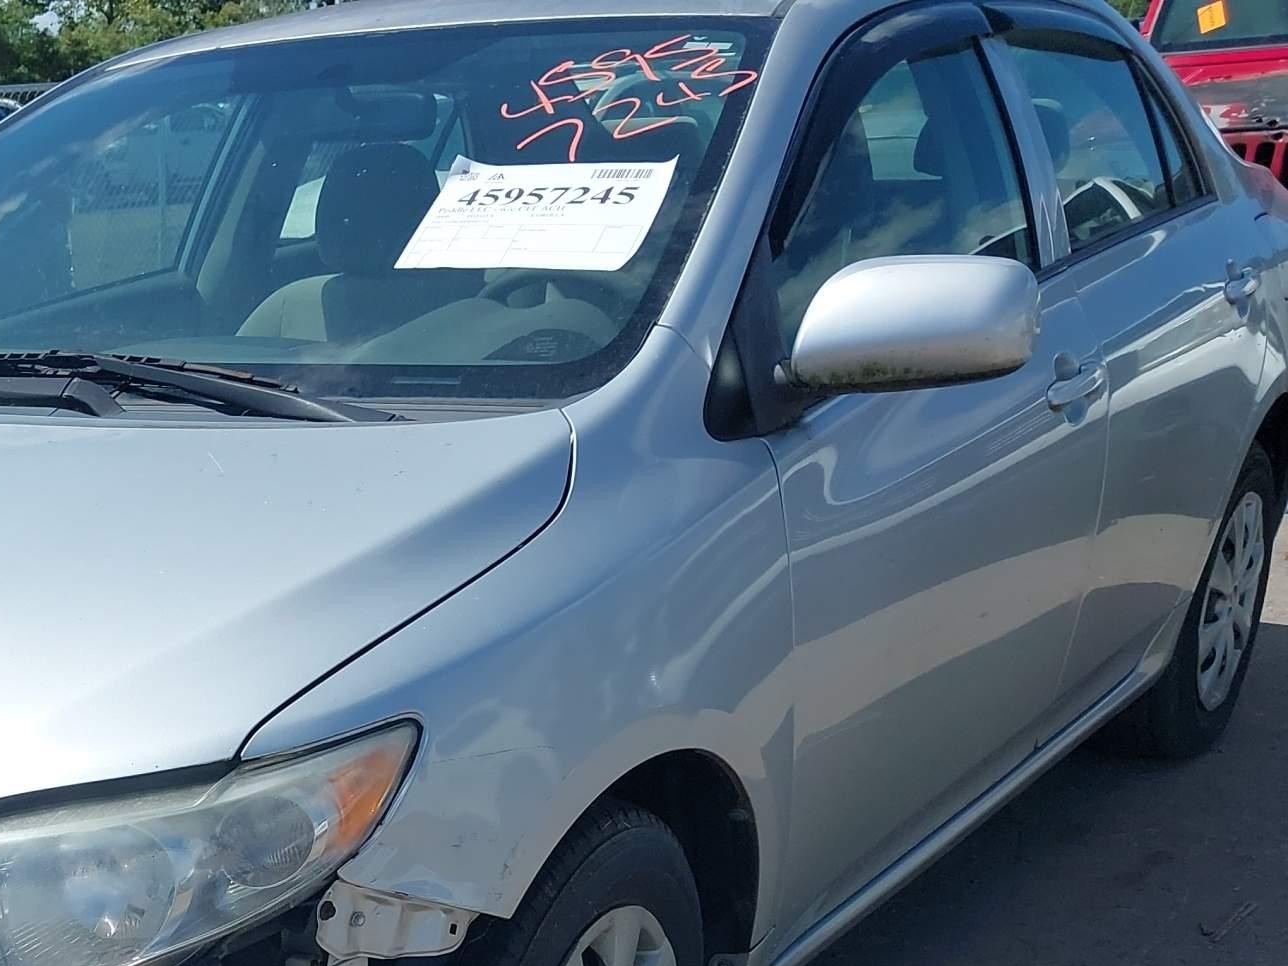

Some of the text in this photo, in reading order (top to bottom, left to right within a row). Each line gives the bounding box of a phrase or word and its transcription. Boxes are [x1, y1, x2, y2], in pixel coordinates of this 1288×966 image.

[500, 34, 719, 118] 4595
[516, 57, 758, 163] 7245
[457, 186, 640, 206] 45957245
